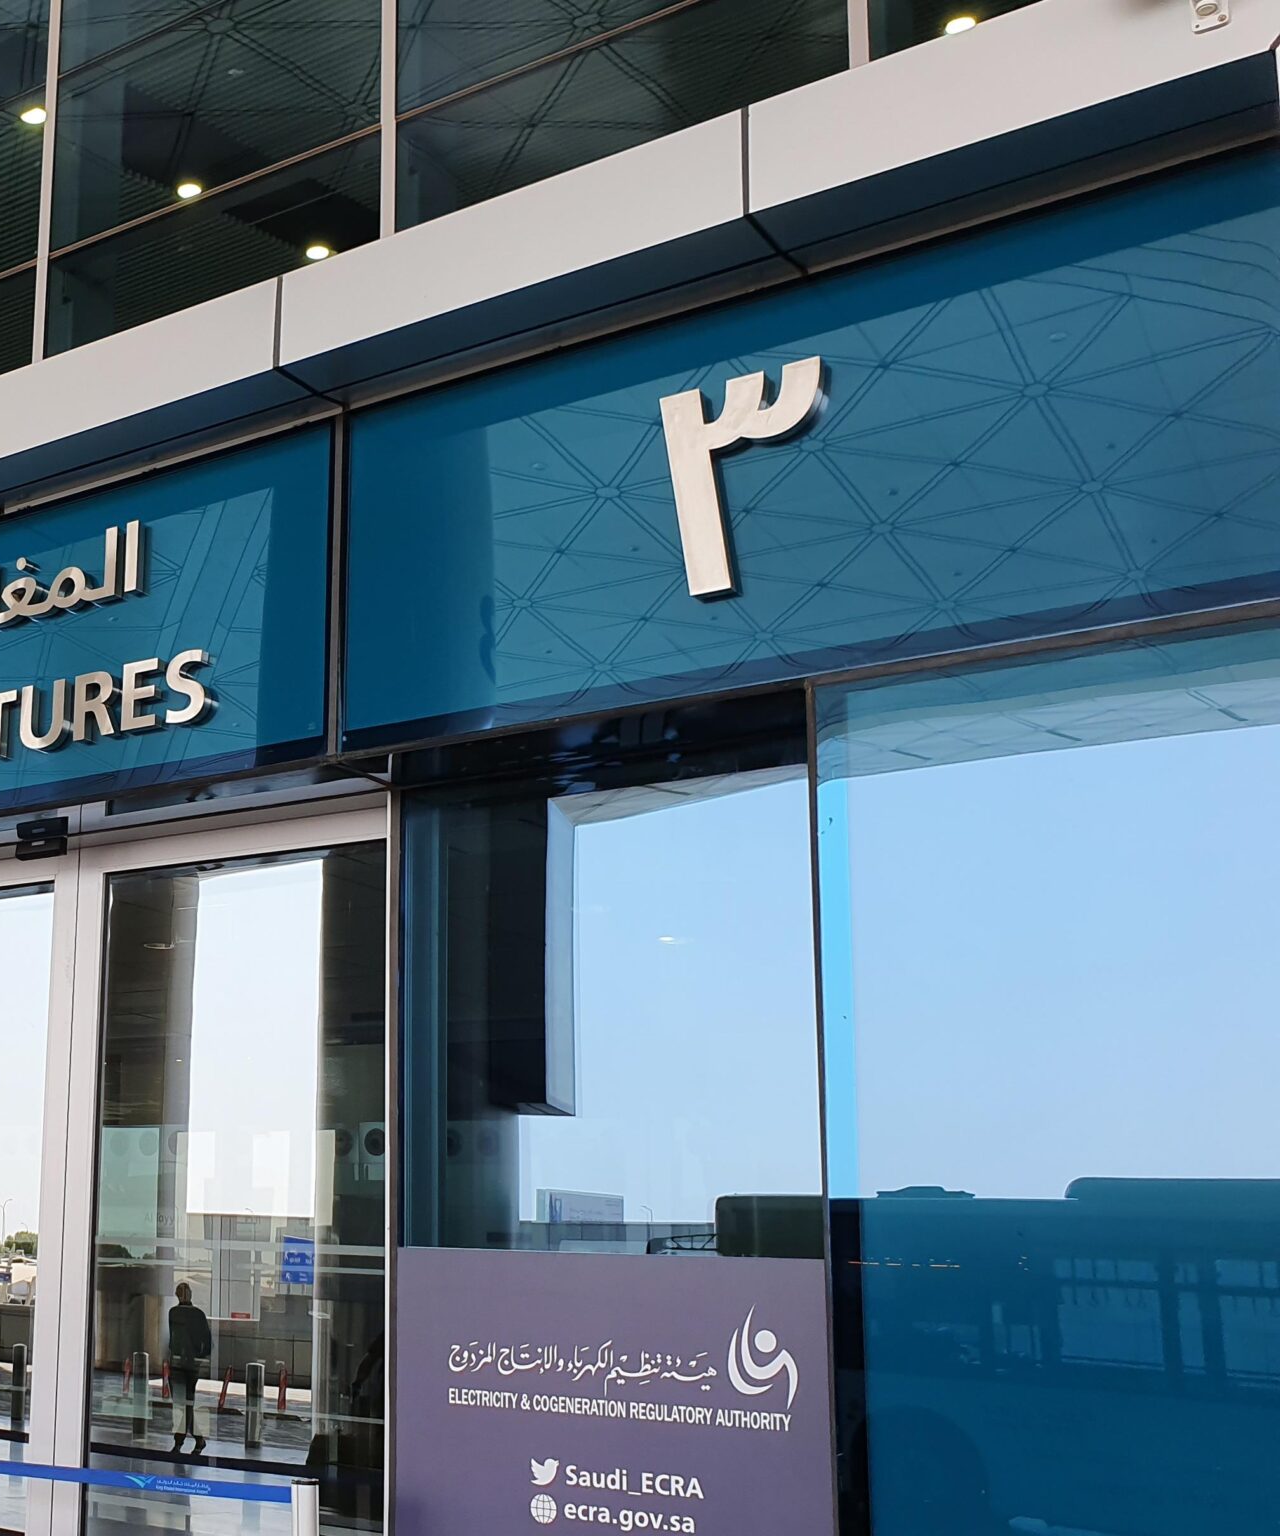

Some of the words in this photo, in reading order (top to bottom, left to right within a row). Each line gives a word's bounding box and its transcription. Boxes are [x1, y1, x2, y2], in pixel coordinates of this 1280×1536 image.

[660, 355, 822, 598] ٣
[448, 1388, 519, 1411] ELECTRICITY
[520, 1394, 532, 1412] &
[532, 1394, 627, 1419] COGENERATION
[629, 1402, 714, 1427] REGULATORY
[715, 1408, 792, 1433] AUTHORITY
[564, 1464, 705, 1500] Saudi_ECRA
[563, 1501, 696, 1534] ecra.gov.sa
